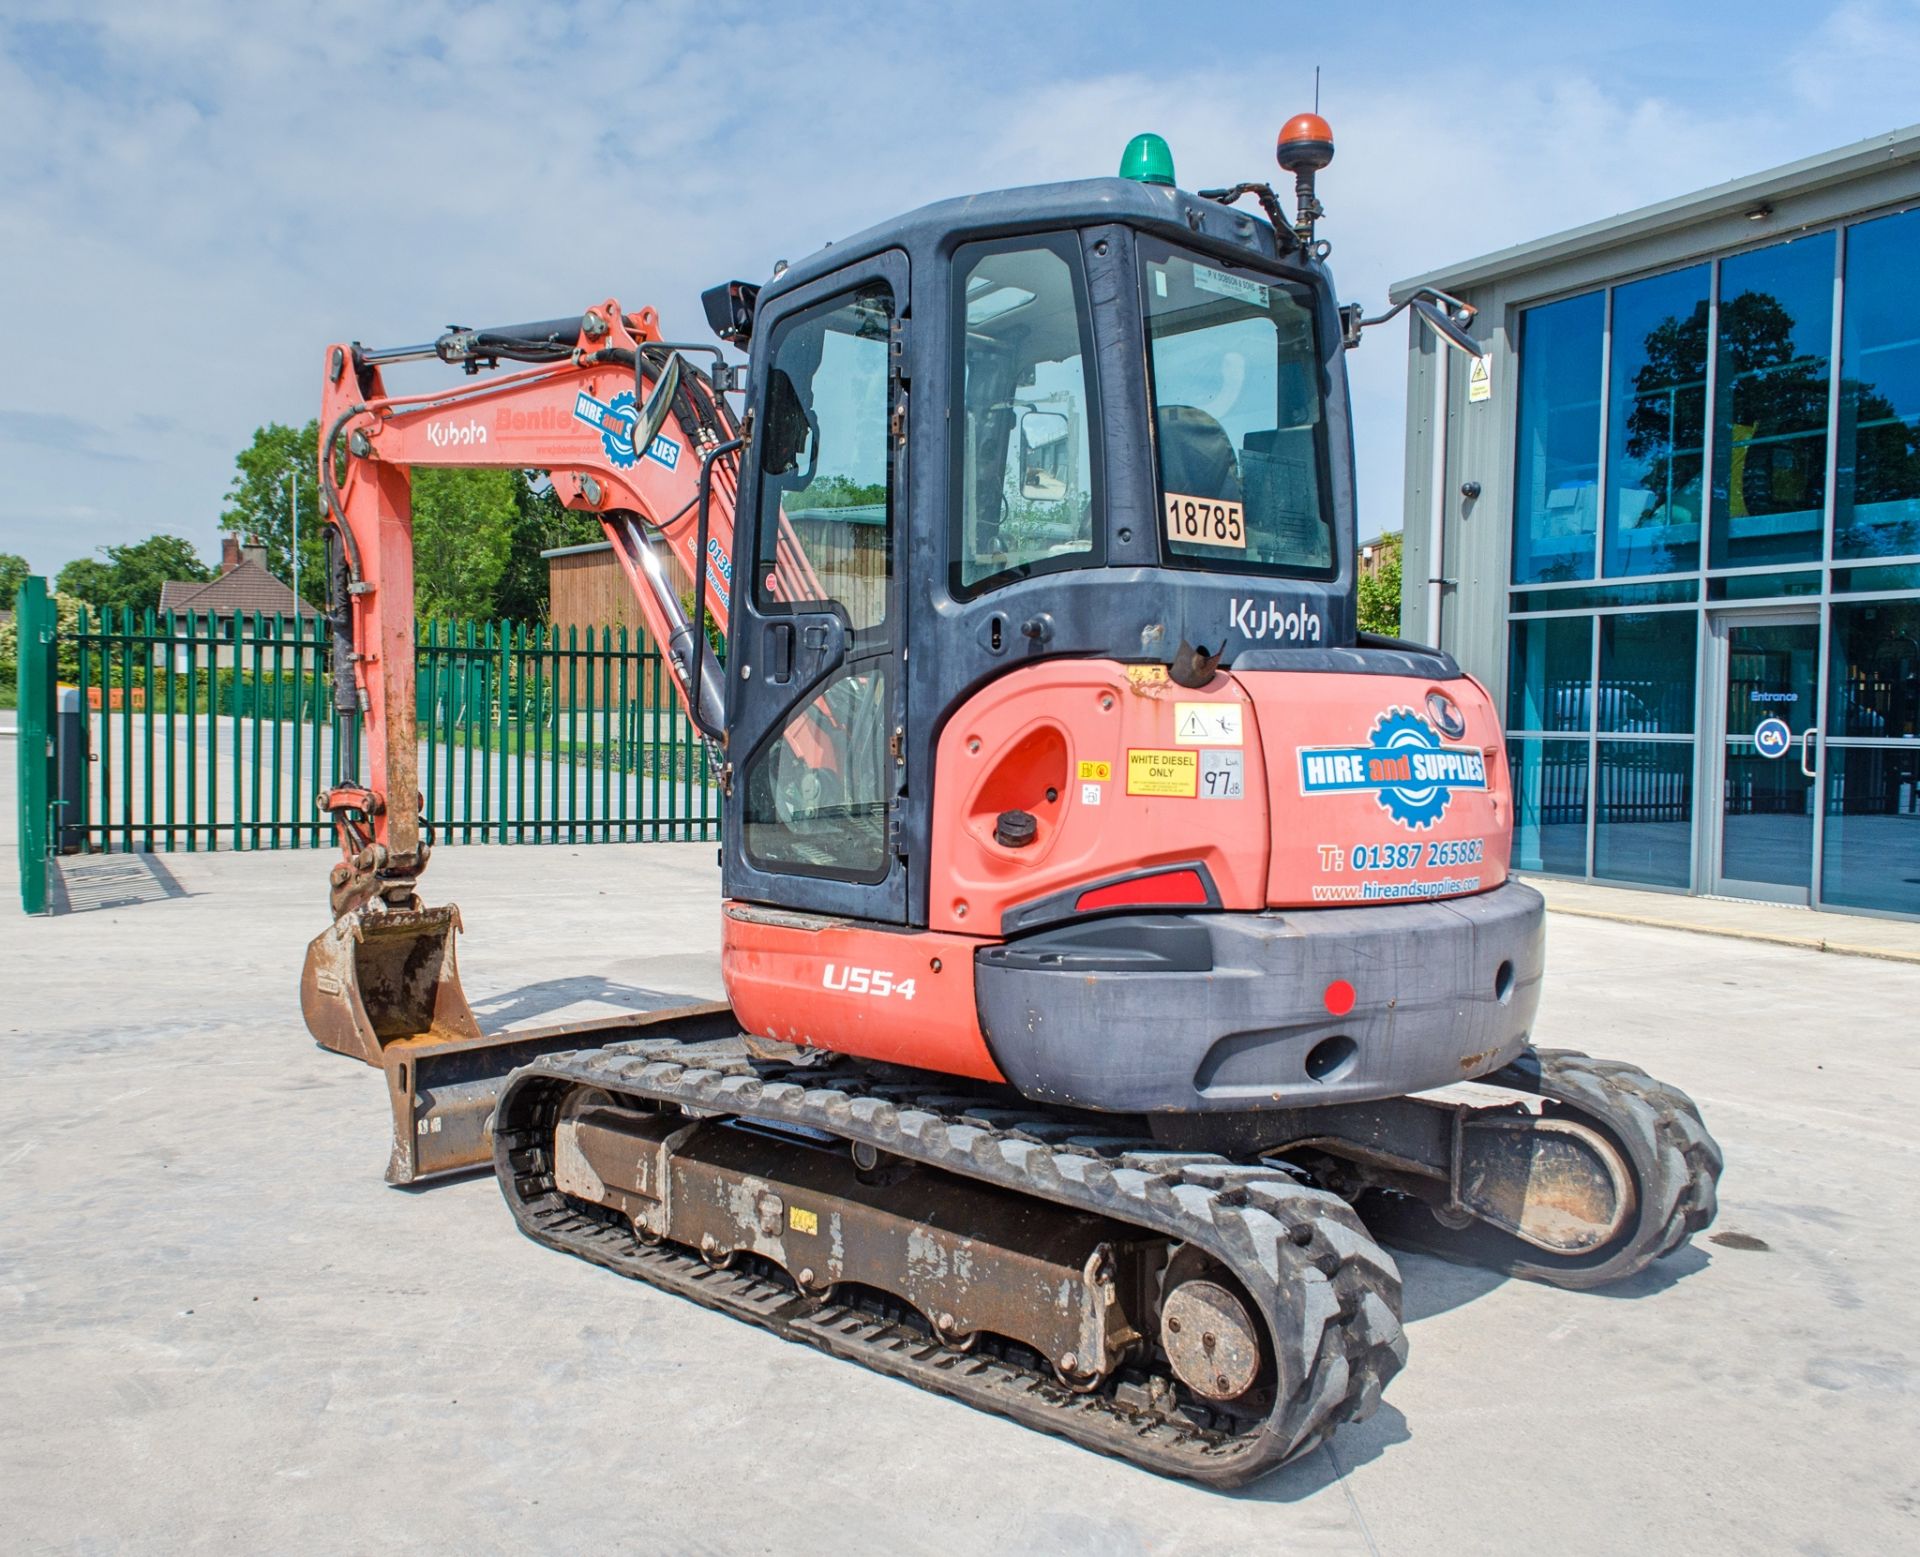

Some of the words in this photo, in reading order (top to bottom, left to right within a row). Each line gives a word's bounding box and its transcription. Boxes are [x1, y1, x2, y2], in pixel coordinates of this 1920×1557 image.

[577, 397, 603, 421] HIRE
[602, 413, 625, 436] and
[427, 419, 487, 447] Kubota
[1170, 500, 1241, 542] 18785
[1230, 598, 1321, 642] Kubota
[1751, 691, 1798, 702] Entrance
[1130, 755, 1159, 765] WHITE
[1162, 756, 1194, 766] DIESEL
[1149, 768, 1174, 778] ONLY
[1307, 755, 1366, 785] HIRE
[1369, 755, 1411, 782] and
[1412, 754, 1484, 782] SUPPLIES
[1204, 771, 1231, 795] 97
[1318, 845, 1344, 872] T:
[1352, 844, 1422, 870] 01387
[1428, 839, 1483, 867] 265882
[1312, 877, 1481, 900] www.hireandsupplies.com
